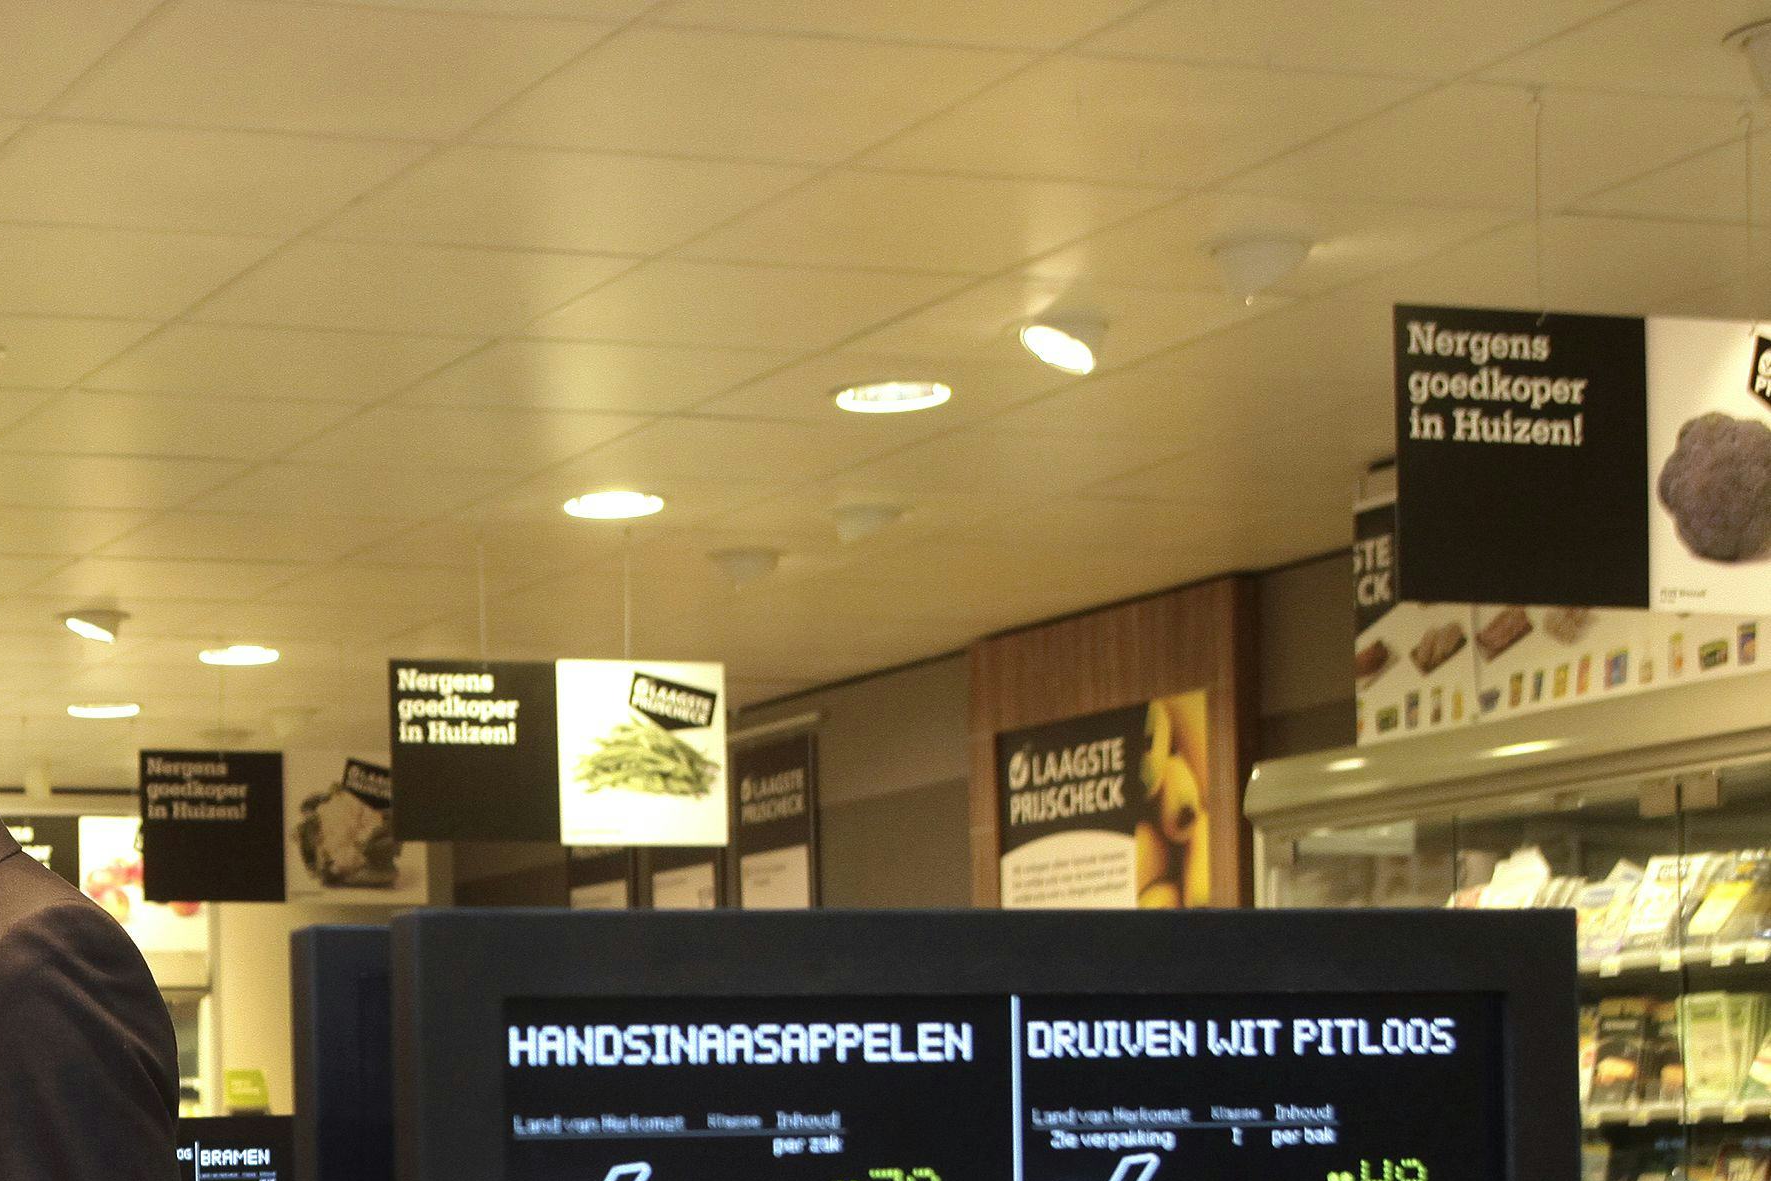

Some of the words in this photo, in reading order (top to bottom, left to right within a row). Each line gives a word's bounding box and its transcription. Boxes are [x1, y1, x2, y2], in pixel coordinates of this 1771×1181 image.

[1407, 321, 1551, 365] Nergens
[1408, 366, 1589, 410] goedkoper
[1409, 409, 1445, 441] in
[1451, 409, 1584, 447] Huizen!
[396, 667, 495, 697] Nergens
[397, 695, 519, 722] goedkoper
[399, 720, 424, 744] in
[427, 720, 517, 745] Huizen!
[147, 757, 227, 779] Nergens
[1031, 737, 1125, 786] LAAGSTE
[147, 779, 249, 802] goedkoper
[1009, 774, 1126, 826] PRIJSCHECK
[148, 799, 169, 819] in
[171, 800, 247, 820] Huizen!
[508, 1020, 974, 1067] HANDSINAASAPPELEN
[1027, 1018, 1197, 1060] DRUIVEN
[1206, 1017, 1283, 1058] WIT
[1292, 1016, 1458, 1057] PITLOOS
[200, 1148, 271, 1167] BRAMEN
